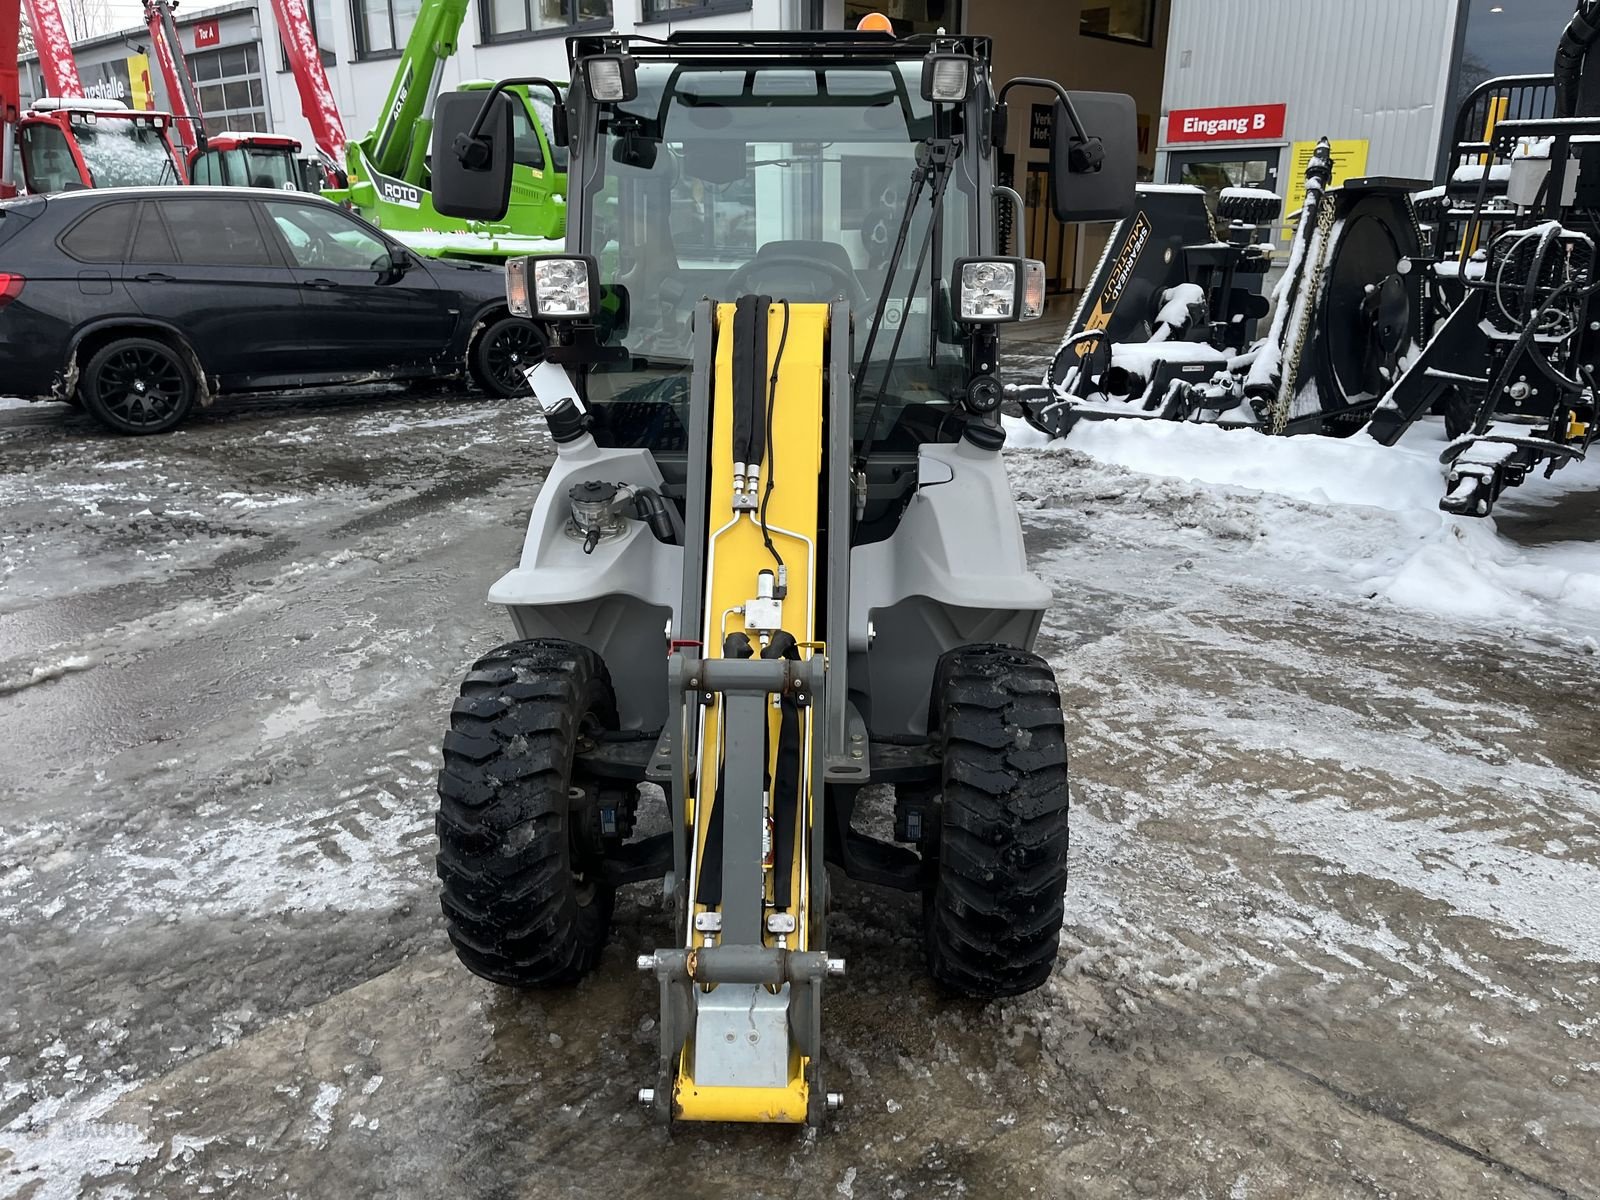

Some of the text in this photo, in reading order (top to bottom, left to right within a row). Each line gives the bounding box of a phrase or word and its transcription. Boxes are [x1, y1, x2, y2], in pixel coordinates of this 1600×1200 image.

[198, 26, 214, 40] Tor A
[1183, 113, 1266, 135] Eingang B
[384, 183, 418, 202] ROTO
[1104, 219, 1144, 303] MULTICUT
[1111, 226, 1148, 300] SPEARHEAD
